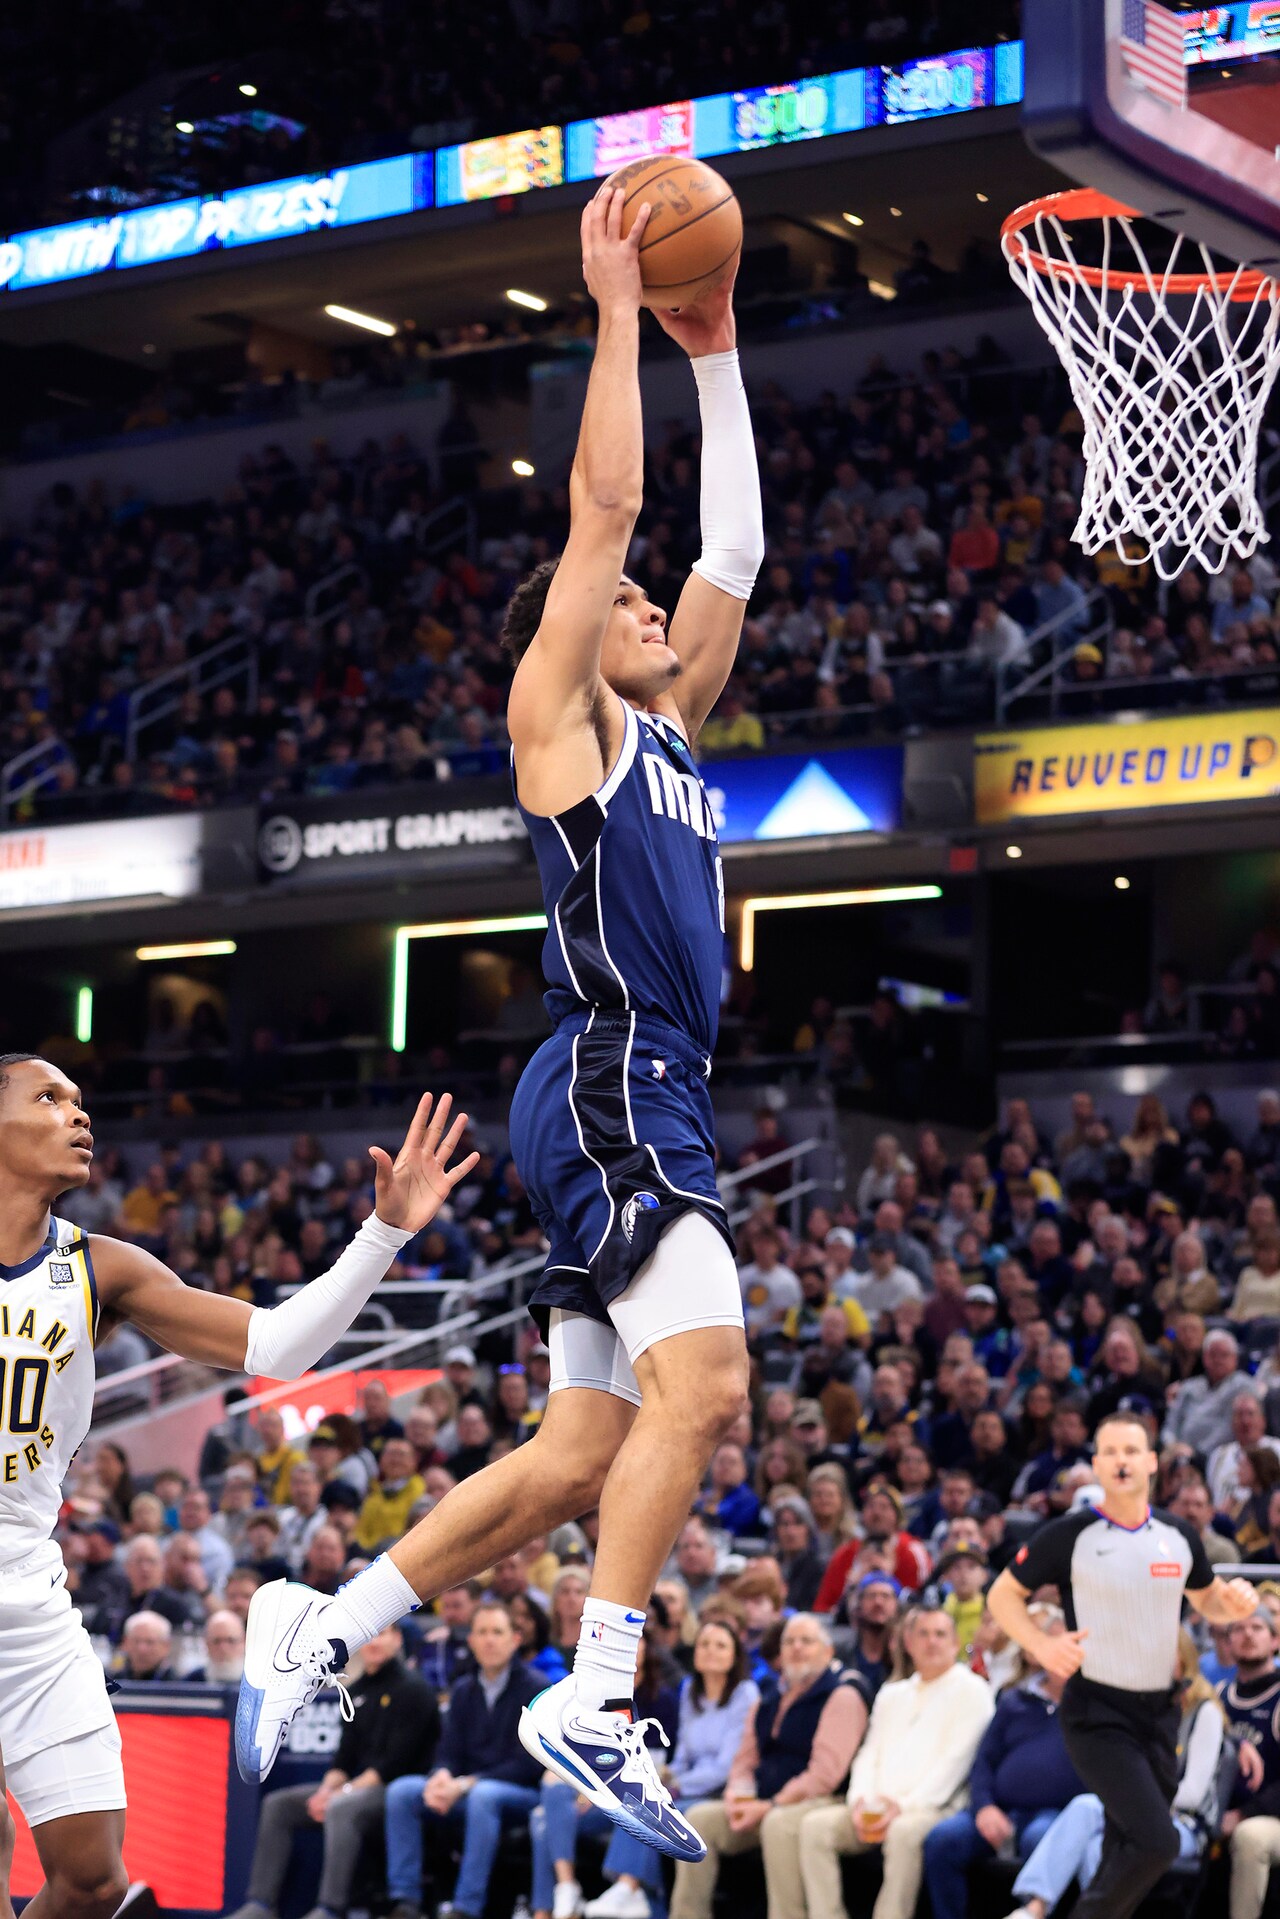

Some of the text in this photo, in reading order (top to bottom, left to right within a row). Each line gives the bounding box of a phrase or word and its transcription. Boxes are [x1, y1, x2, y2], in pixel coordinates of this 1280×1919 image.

[24, 216, 123, 277] WITH
[122, 207, 195, 260] TOP
[194, 171, 350, 246] PRIZES!
[1010, 747, 1168, 793] REVVED
[1179, 742, 1232, 781] UP
[303, 817, 391, 858] SPORT
